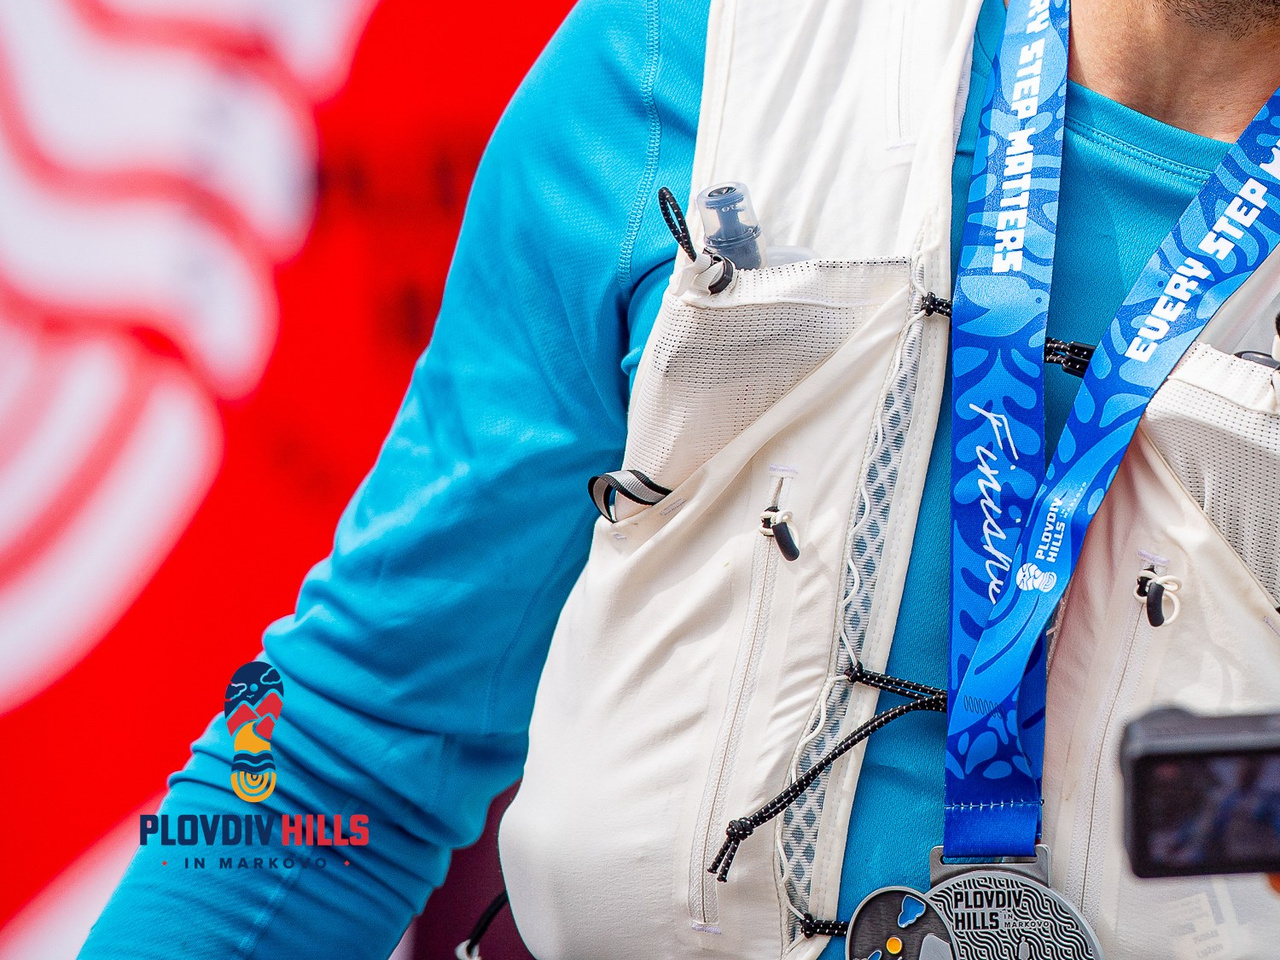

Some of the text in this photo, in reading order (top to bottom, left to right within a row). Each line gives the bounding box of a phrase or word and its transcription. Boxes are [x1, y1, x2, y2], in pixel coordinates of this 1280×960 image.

[1011, 38, 1045, 120] STEP
[992, 127, 1034, 274] MATTERS
[1198, 178, 1268, 260] STEP
[1035, 497, 1063, 560] PLOVDIV
[1046, 521, 1066, 563] HILLS
[953, 890, 1023, 909] PLOVDIV
[954, 912, 1000, 930] HILLS
[1004, 920, 1050, 928] MARKOVO
